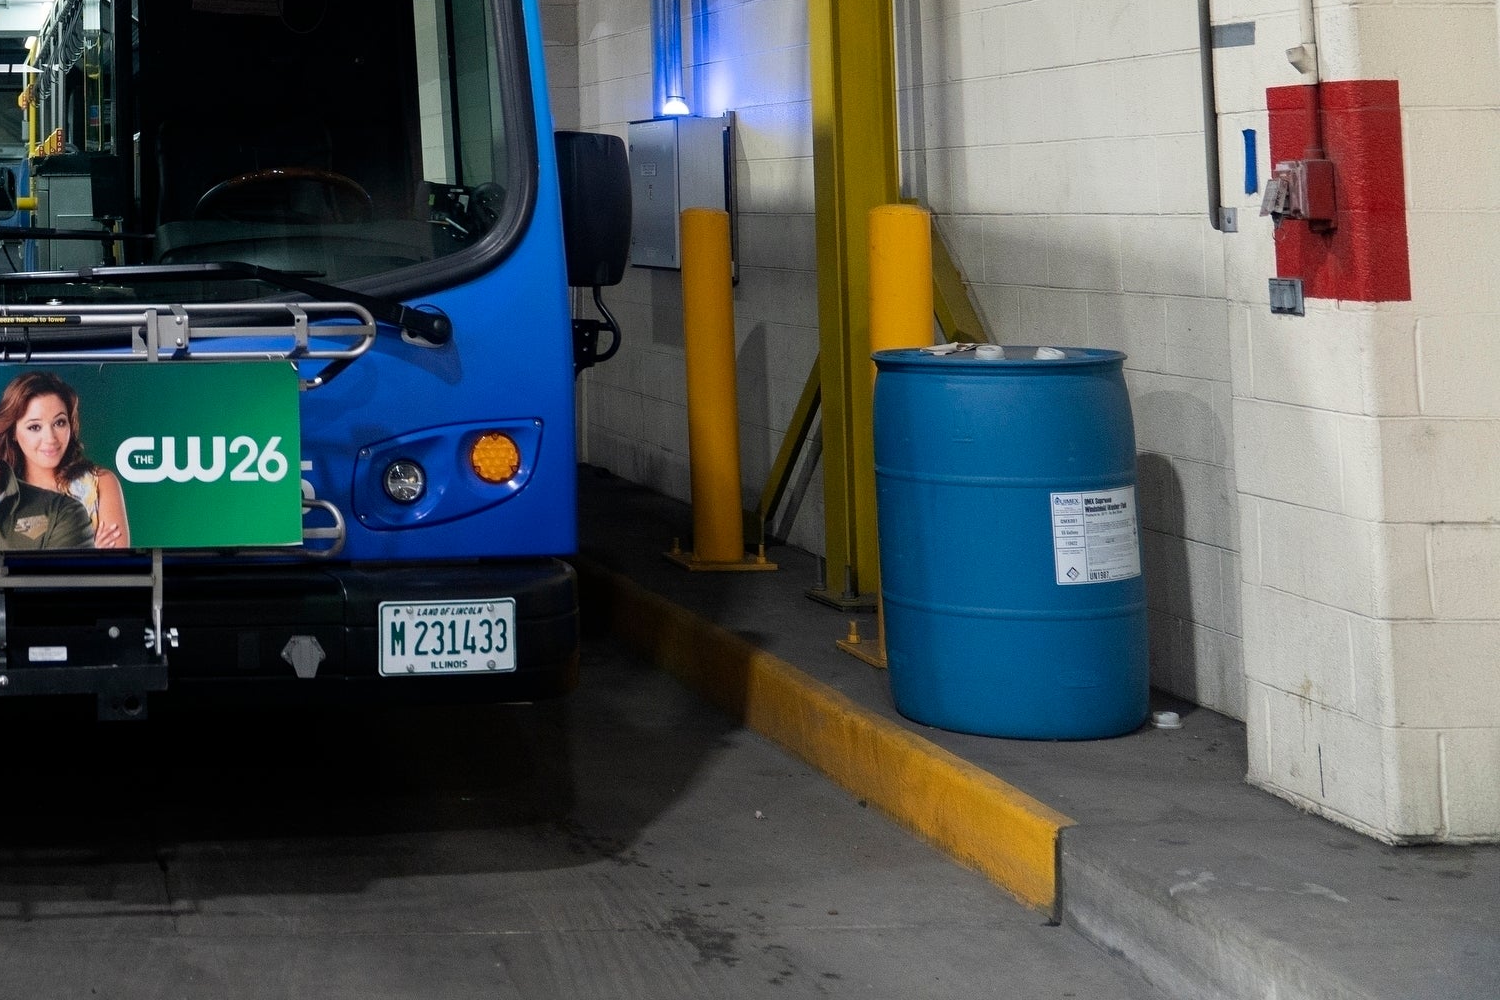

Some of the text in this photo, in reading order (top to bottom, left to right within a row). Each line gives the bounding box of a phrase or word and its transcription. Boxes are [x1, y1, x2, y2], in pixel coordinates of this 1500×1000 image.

[133, 454, 155, 465] THE
[393, 608, 400, 616] P
[417, 606, 484, 616] LAND OF LINCOLN
[390, 618, 508, 656] M 231433
[430, 659, 469, 670] ILLINOIS
